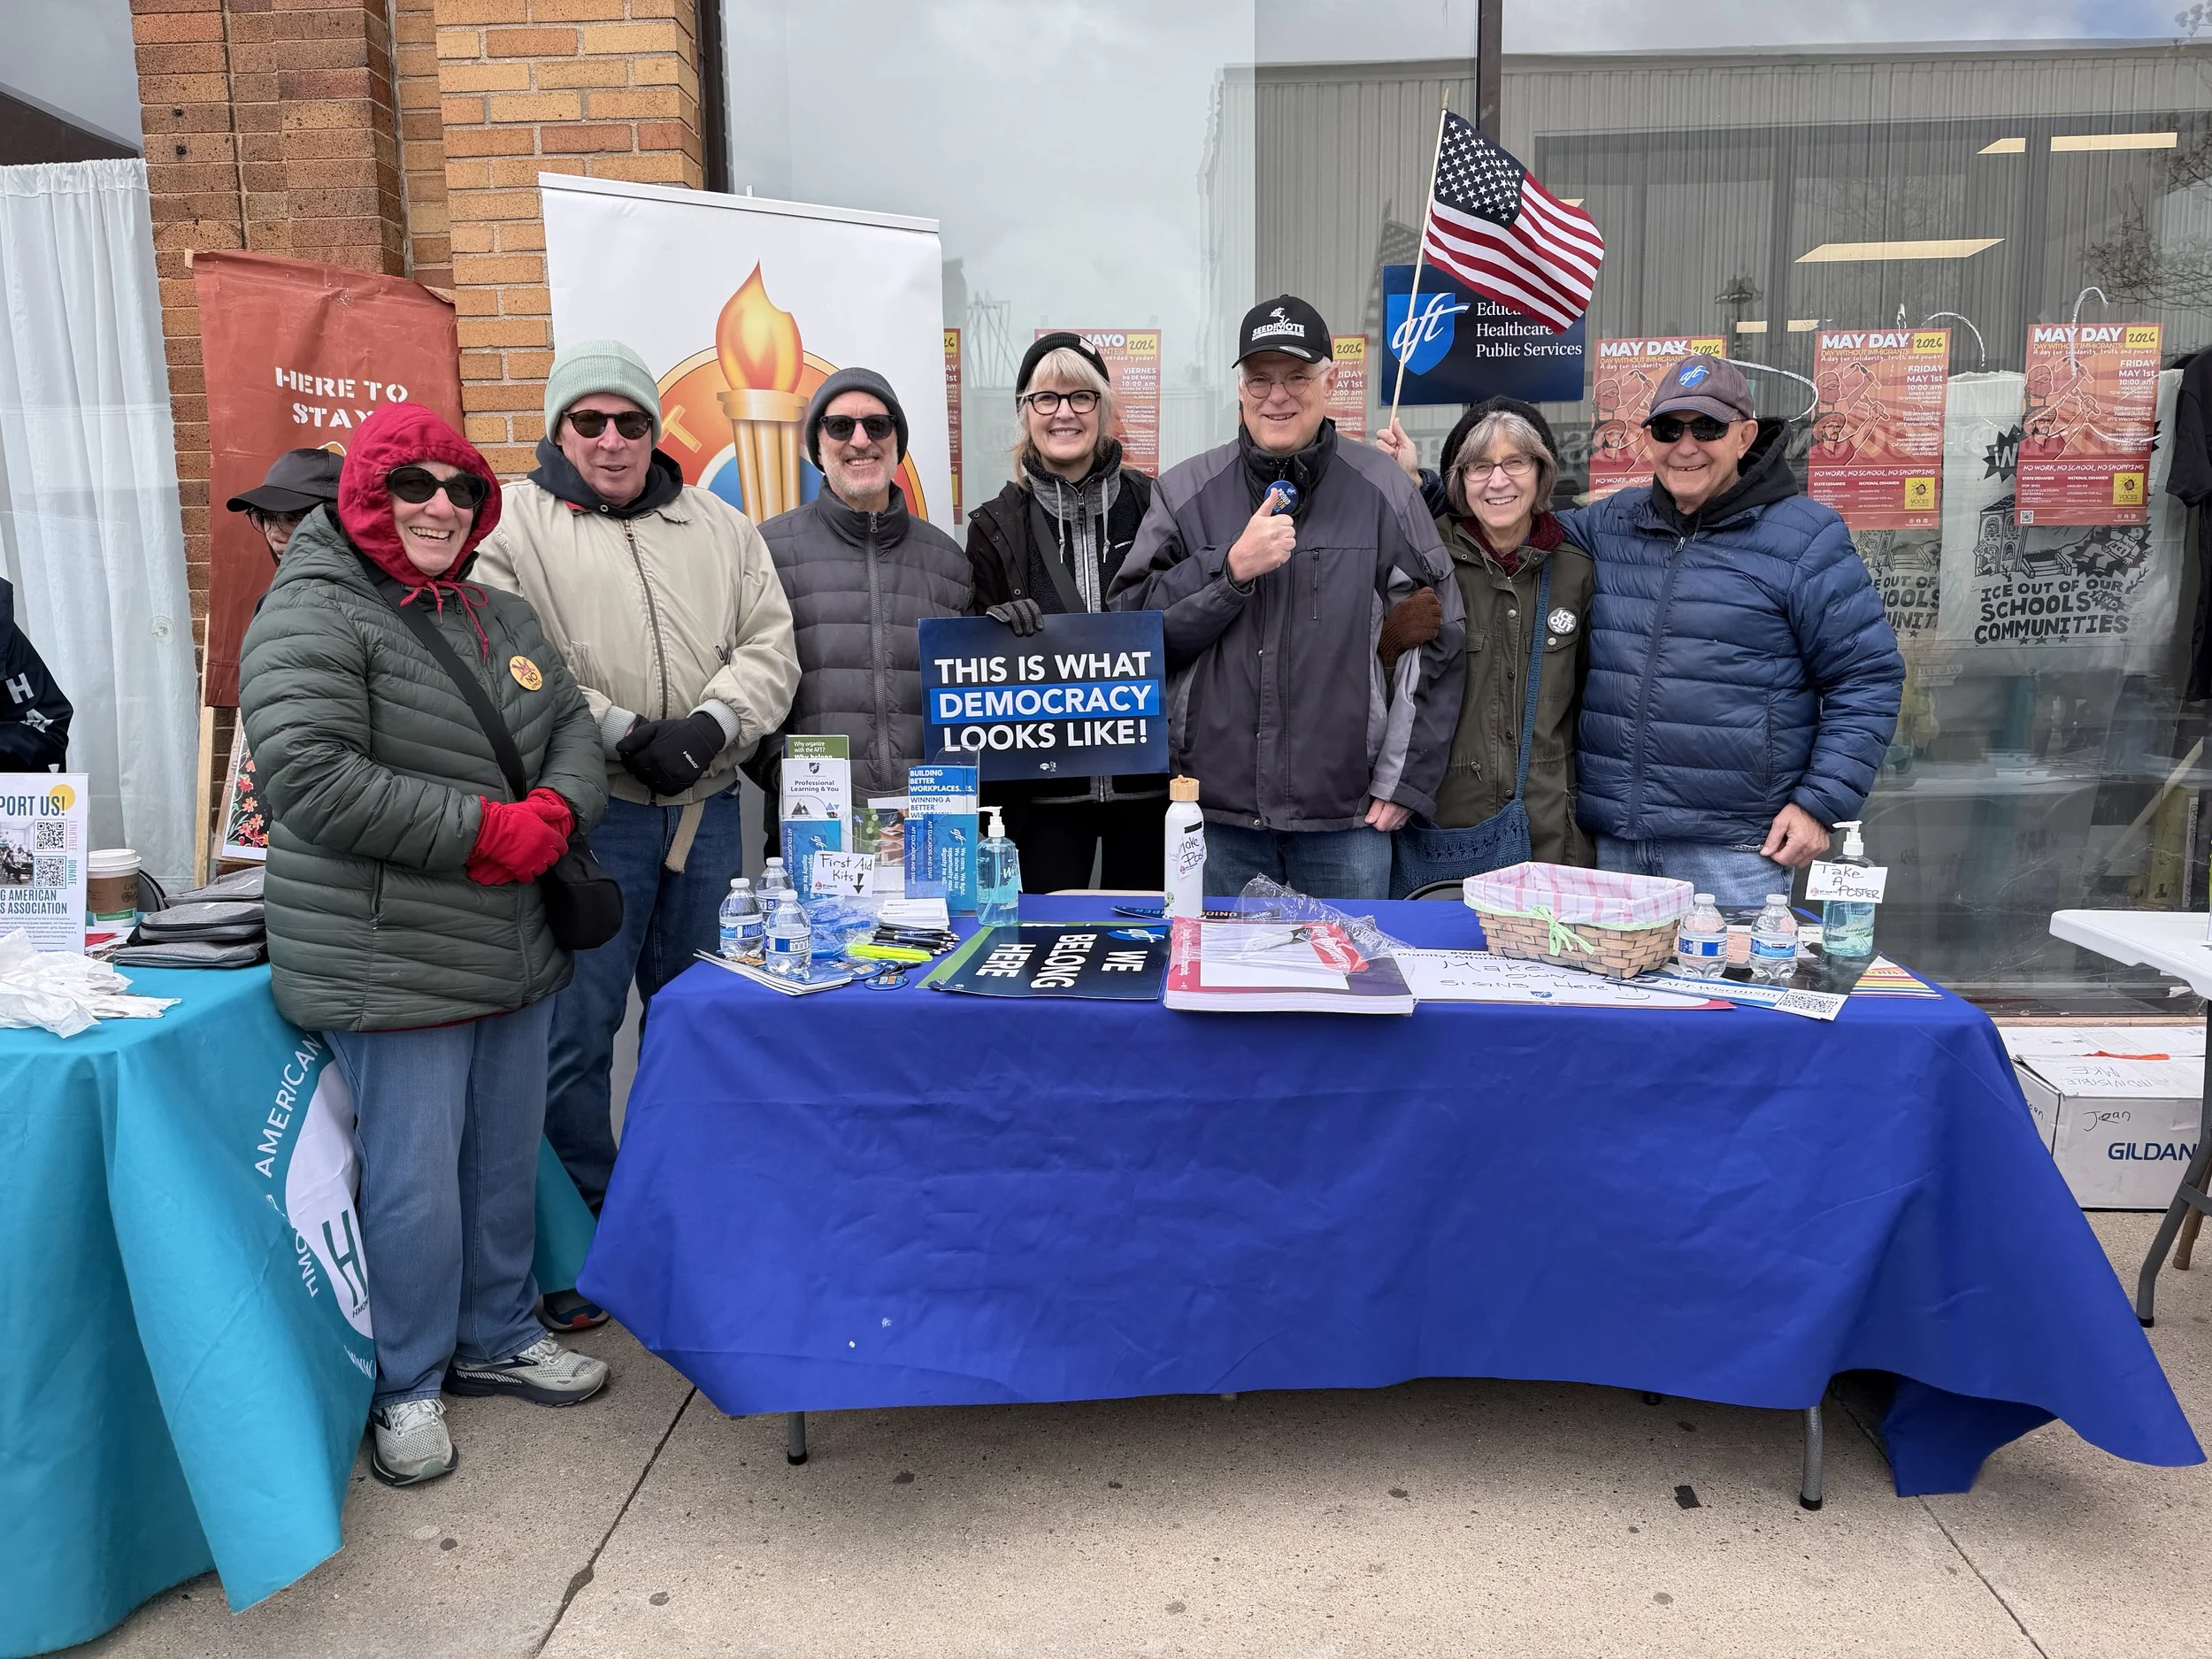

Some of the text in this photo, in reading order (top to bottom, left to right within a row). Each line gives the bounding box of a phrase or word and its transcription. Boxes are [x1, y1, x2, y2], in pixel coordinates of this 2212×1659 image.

[1252, 324, 1273, 337] SEED
[1392, 293, 1471, 365] aft
[1477, 322, 1554, 337] Healthcare
[2034, 327, 2124, 342] MAY DAY
[1822, 333, 1910, 349] MAY DAY
[1916, 337, 1943, 349] 2026
[2129, 332, 2155, 342] 2026
[1129, 340, 1155, 350] 2026
[1336, 343, 1362, 354] 2026
[1477, 342, 1582, 357] Public Services
[1601, 341, 1687, 357] MAY DAY
[1694, 344, 1720, 356] 2026
[1679, 365, 1709, 386] aft
[275, 367, 408, 403] HERE TO
[1883, 576, 1937, 588] OUT OF
[1981, 578, 2123, 603] ICE OUT OF OUR
[1981, 590, 2091, 622] SCHOOLS
[2093, 591, 2118, 609] AND
[1550, 616, 1573, 632] OUT
[1557, 610, 1575, 624] ICE
[1974, 615, 2130, 645] COMMUNITIES
[934, 651, 1151, 684] THIS IS WHAT
[525, 672, 538, 685] NO
[939, 685, 1152, 718] DEMOCRACY
[944, 718, 1148, 752] LOOKS LIKE!
[682, 750, 700, 769] HEAD
[40, 795, 65, 816] US!
[68, 820, 78, 851] LINKTREE
[955, 847, 959, 856] We
[960, 847, 965, 856] We
[819, 854, 872, 872] First Aid
[67, 859, 77, 886] DONATE
[833, 870, 854, 881] Kits
[960, 872, 965, 881] We
[1814, 864, 1864, 879] Take
[1832, 876, 1843, 887] A
[8, 889, 57, 902] AMERICAN
[7, 902, 67, 914] ASSOCIATION
[975, 943, 1036, 978] HERE
[1030, 933, 1098, 988] BELONG
[1101, 950, 1148, 972] WE
[1443, 960, 1544, 972] Make
[1440, 979, 1609, 991] SIGNS Here
[2066, 1065, 2121, 1078] MKE
[255, 1034, 323, 1179] AMERICAN
[2108, 1142, 2199, 1161] GILDAN
